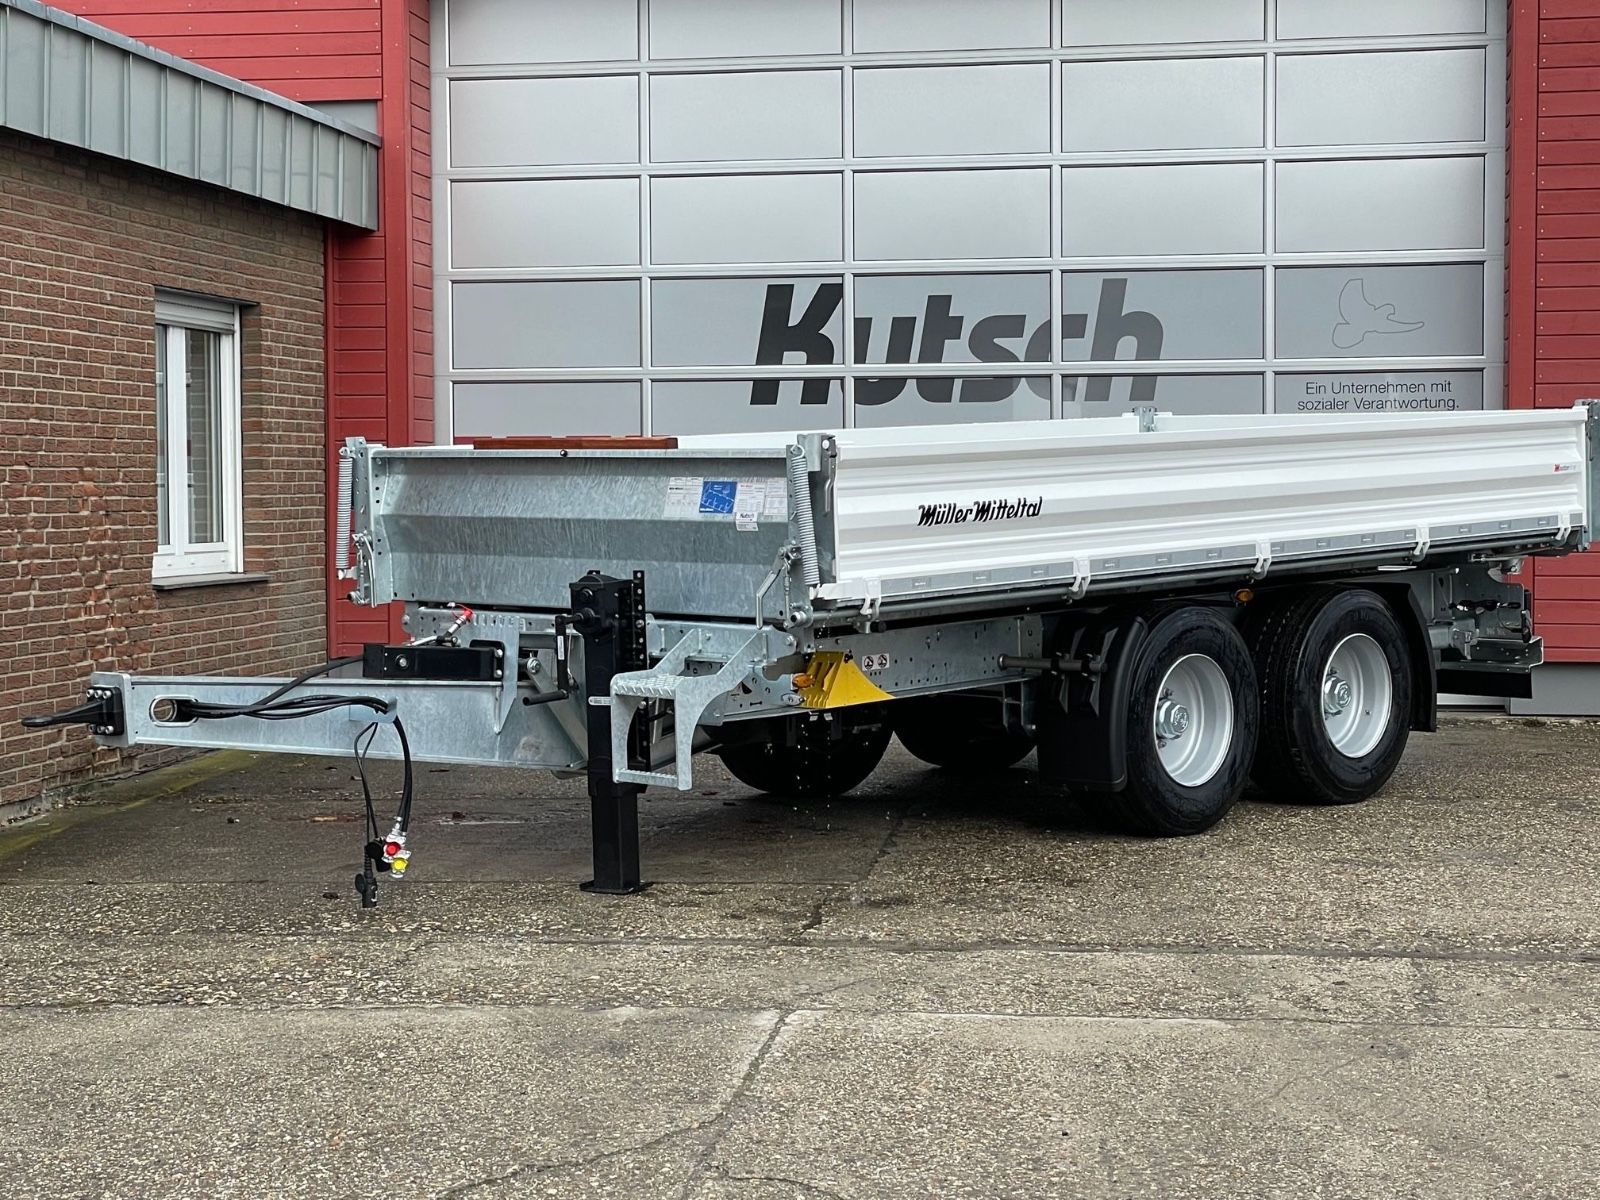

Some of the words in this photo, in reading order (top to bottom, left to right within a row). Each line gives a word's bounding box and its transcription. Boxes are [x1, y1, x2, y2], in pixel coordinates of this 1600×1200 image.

[750, 278, 1164, 405] Kutsch
[1305, 381, 1327, 395] Ein
[1331, 381, 1426, 395] Unternehmen
[1430, 379, 1452, 393] mit
[1297, 398, 1350, 411] sozialer
[1353, 397, 1460, 411] Verantwortung.
[917, 503, 973, 526] Müller
[972, 496, 1043, 522] Mitteltal
